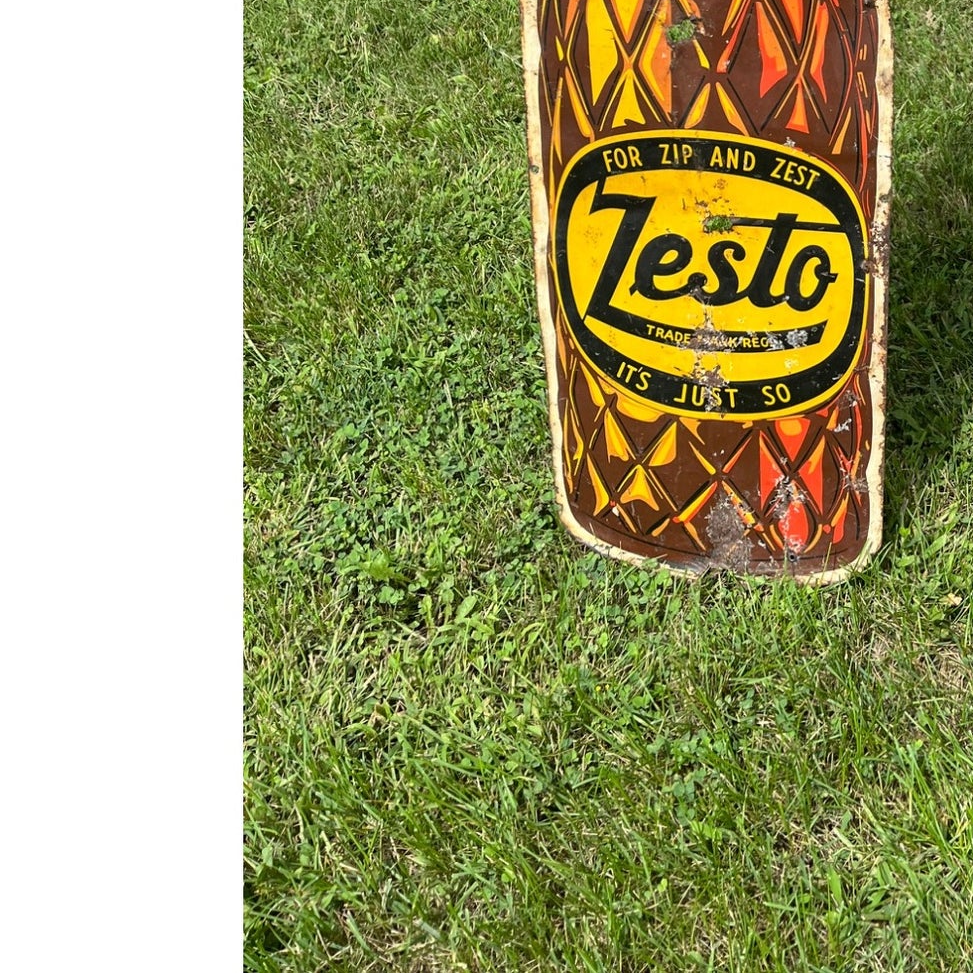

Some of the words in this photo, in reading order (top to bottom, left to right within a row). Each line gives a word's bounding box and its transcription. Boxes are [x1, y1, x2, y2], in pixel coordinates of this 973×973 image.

[603, 145, 642, 172] FOR
[658, 143, 693, 165] ZIP
[709, 145, 756, 172] AND
[769, 157, 821, 191] ZEST
[572, 177, 846, 343] Zesto
[646, 324, 692, 344] TRADE
[616, 361, 651, 391] IT'S
[673, 383, 739, 410] JUST
[763, 383, 792, 407] SO
